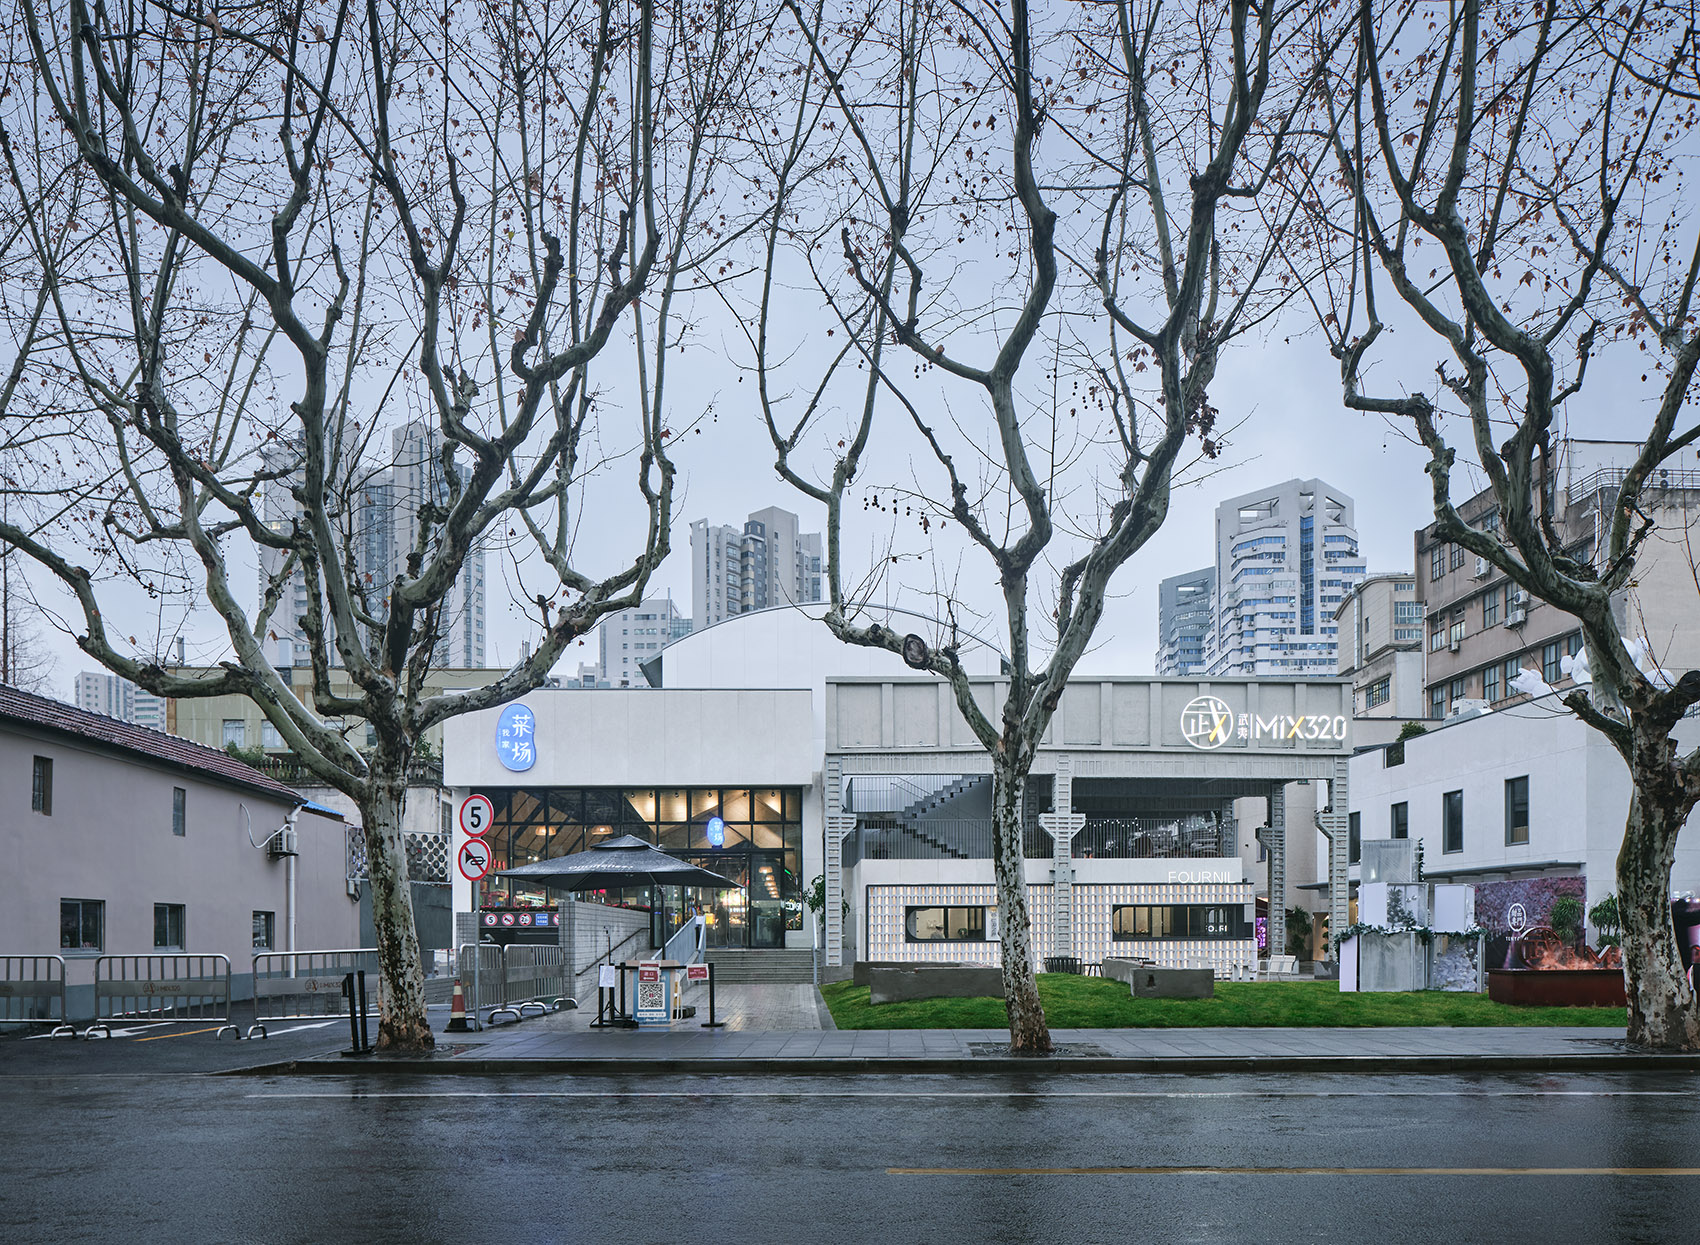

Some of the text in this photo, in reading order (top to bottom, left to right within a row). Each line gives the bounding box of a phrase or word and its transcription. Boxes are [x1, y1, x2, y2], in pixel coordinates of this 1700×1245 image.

[511, 714, 532, 763] 菜场
[1237, 713, 1249, 740] 武夷
[470, 806, 482, 829] 5
[1168, 871, 1236, 884] FOURNIL
